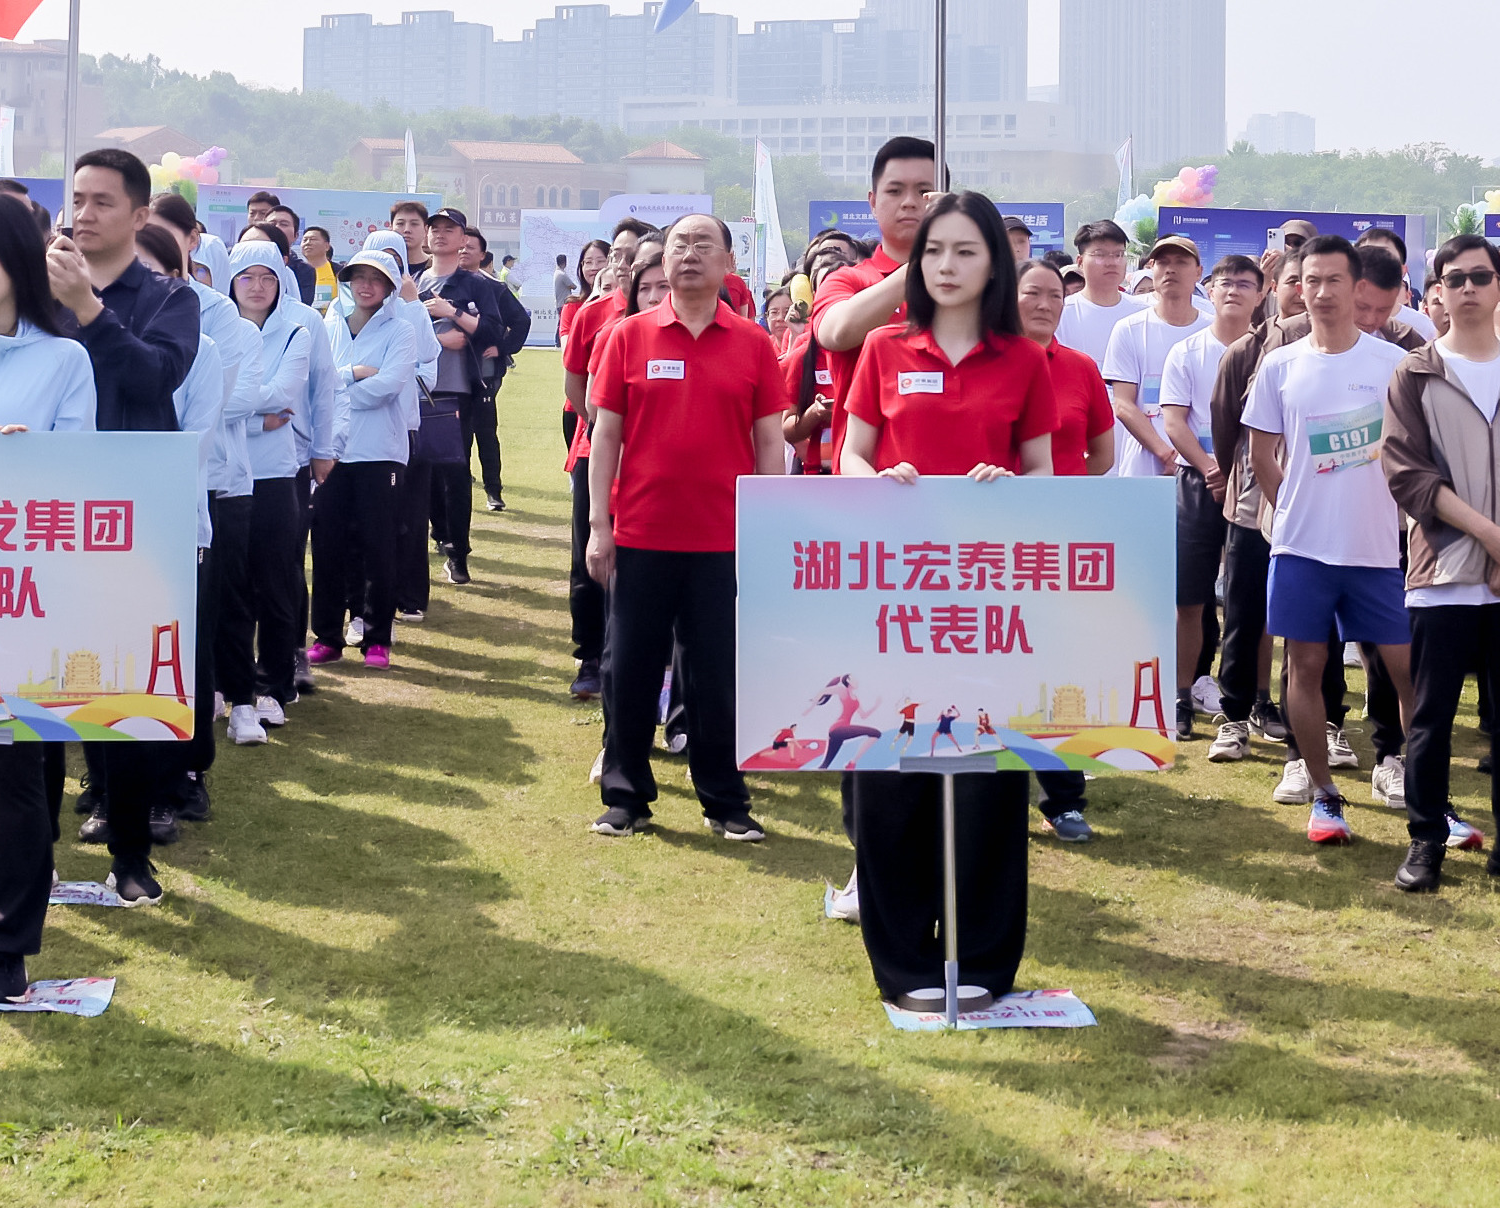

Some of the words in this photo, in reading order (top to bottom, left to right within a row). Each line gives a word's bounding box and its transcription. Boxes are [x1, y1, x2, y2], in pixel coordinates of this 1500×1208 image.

[1329, 427, 1369, 451] C197
[792, 540, 1115, 591] 湖北宏泰集团
[875, 604, 1034, 654] 代表队
